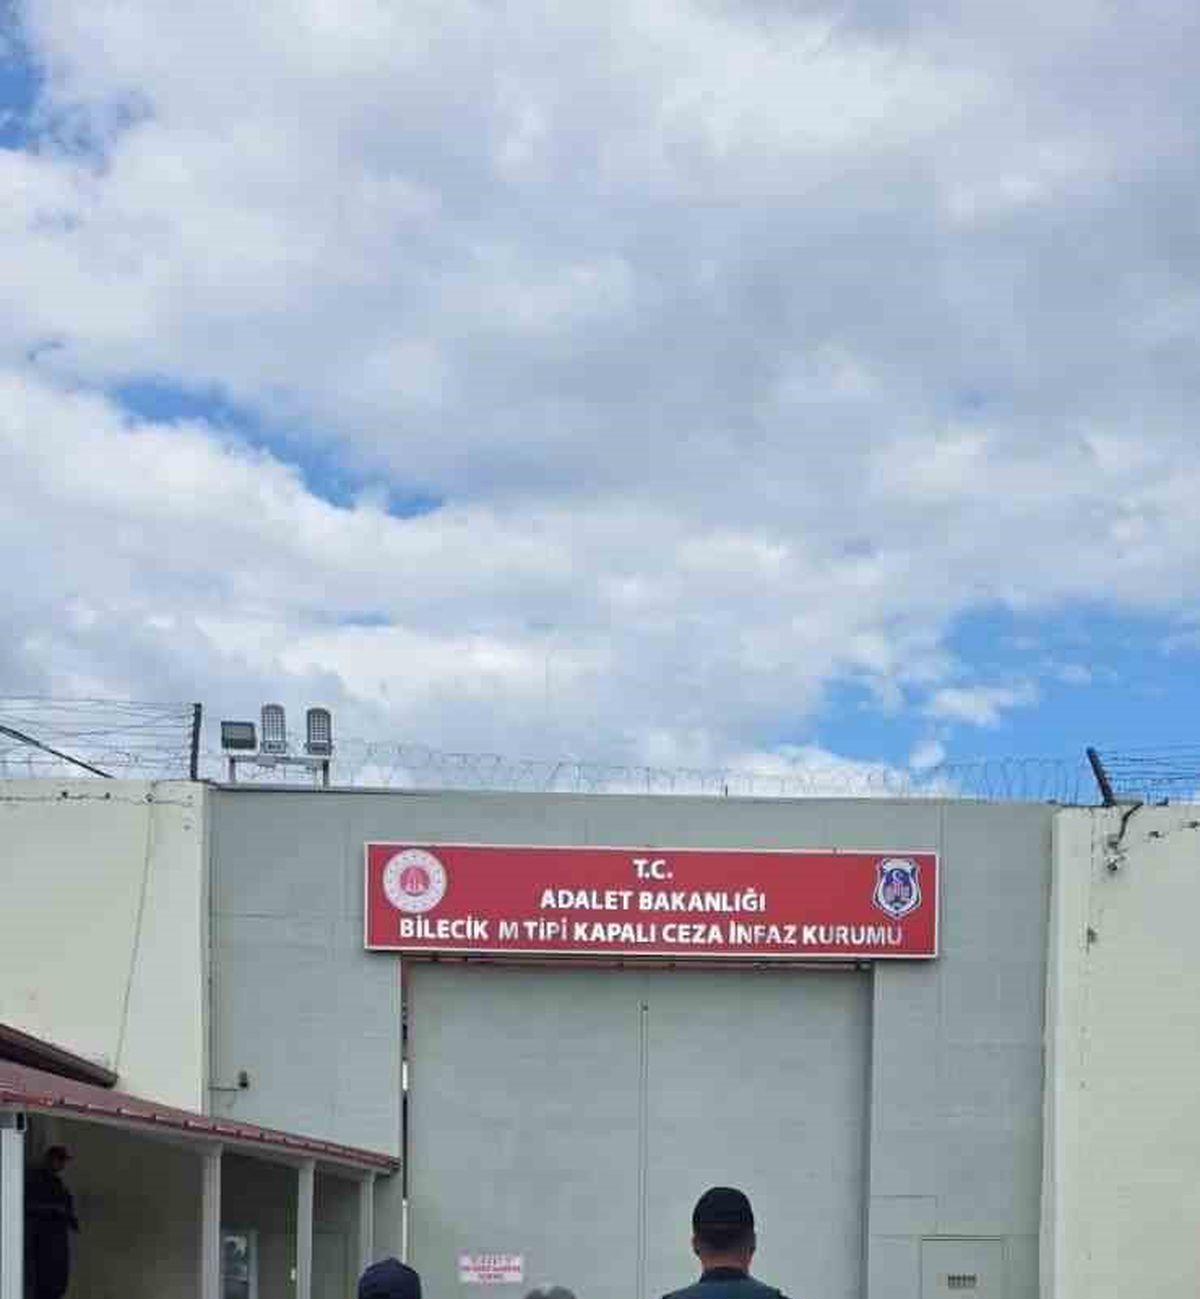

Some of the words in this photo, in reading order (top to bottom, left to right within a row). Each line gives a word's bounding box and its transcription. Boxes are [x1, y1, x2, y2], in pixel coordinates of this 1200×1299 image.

[633, 859, 674, 880] T.C.
[540, 888, 633, 911] ADALET
[639, 887, 766, 913] BAKANLIĞI
[400, 915, 489, 940] BİLECİK
[499, 920, 519, 940] M
[524, 917, 568, 941] TİPİ
[573, 921, 656, 943] KAPALI
[662, 923, 723, 944] CEZA
[728, 919, 797, 945] İNFAZ
[802, 924, 902, 945] KURUMU
